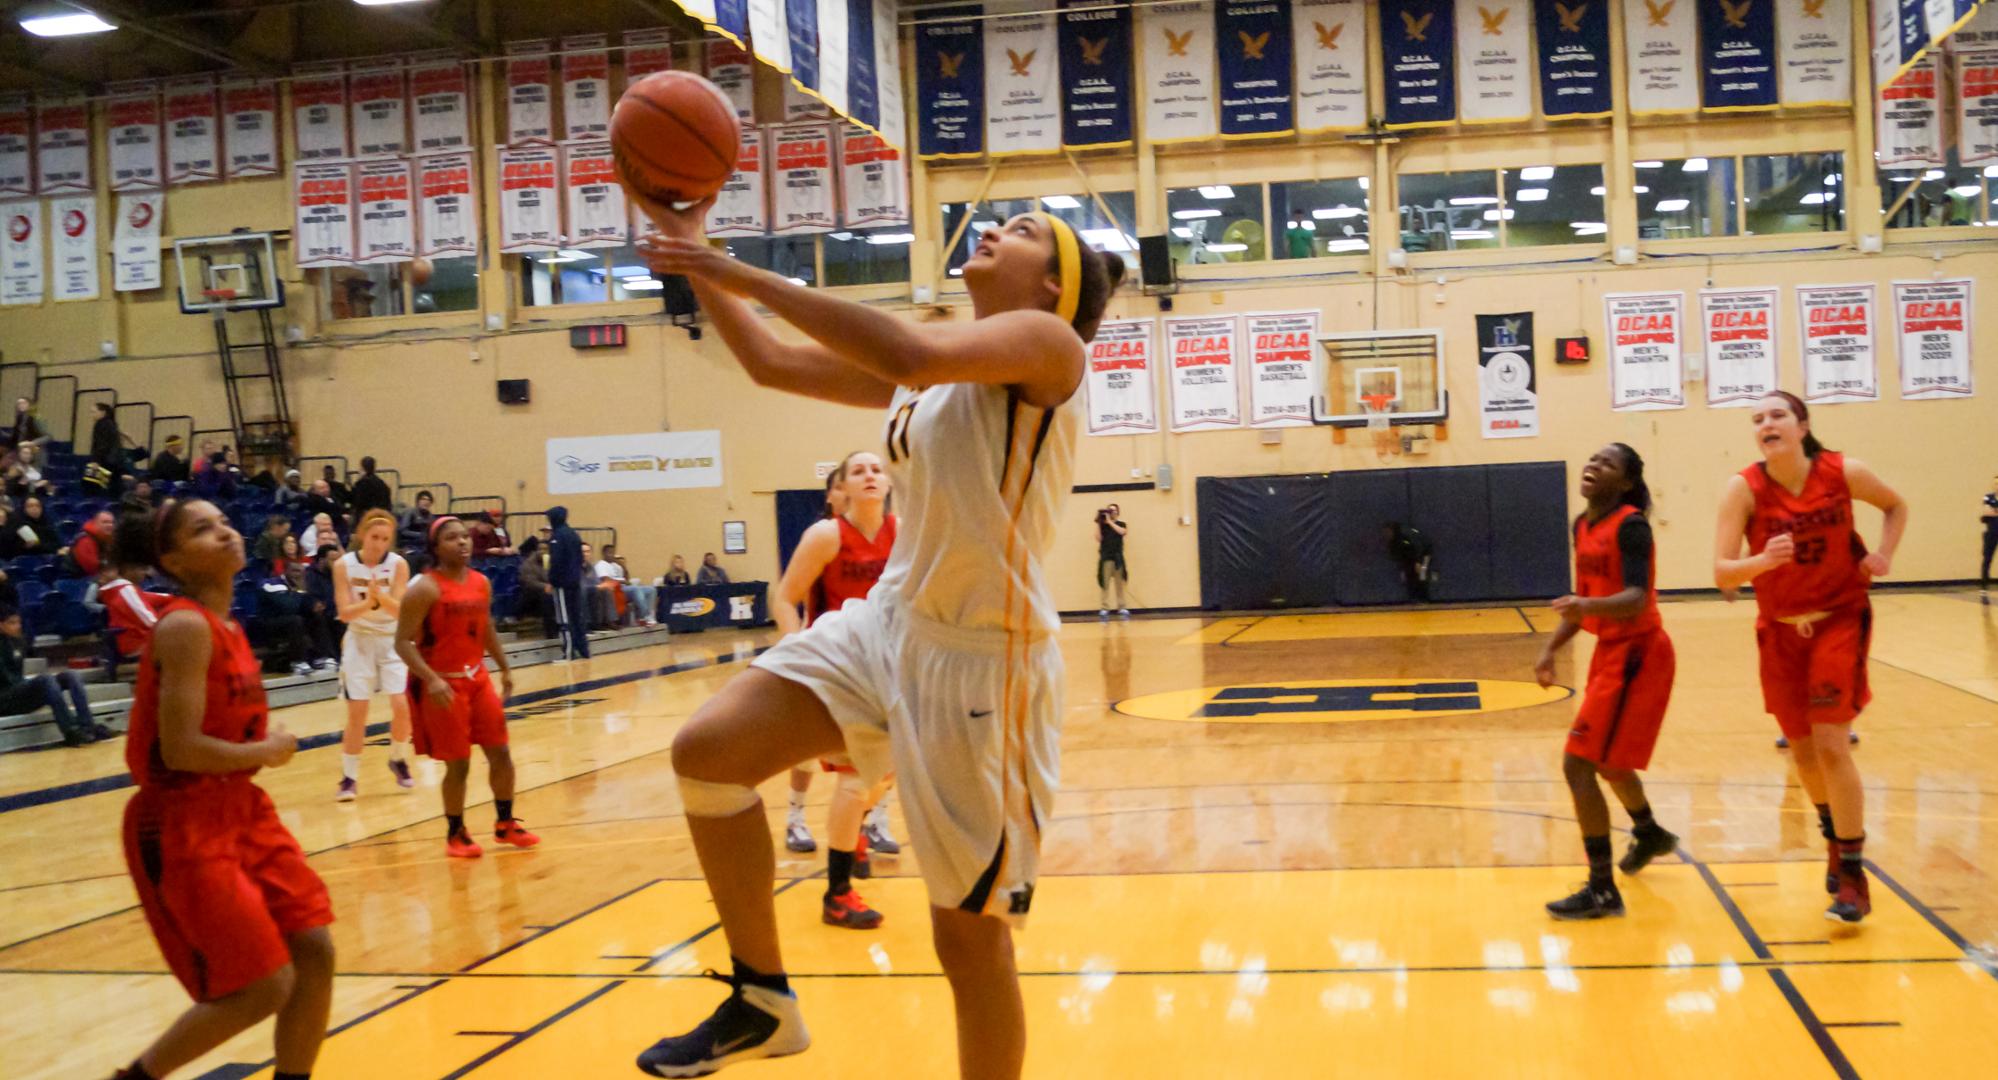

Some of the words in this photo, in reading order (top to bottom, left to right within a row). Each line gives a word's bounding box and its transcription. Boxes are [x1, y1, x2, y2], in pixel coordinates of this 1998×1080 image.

[1905, 301, 1962, 318] OCAA
[1810, 306, 1865, 323] OCAA
[1618, 315, 1673, 331] OCAA
[1711, 311, 1768, 328] OCAA
[1255, 333, 1309, 350] OCAA
[1820, 337, 1857, 346] WOMEN'S
[1922, 334, 1949, 342] MEN'S
[1092, 341, 1145, 358] OCAA
[1176, 336, 1229, 354] OCAA
[1722, 342, 1762, 350] WOMEN'S
[1633, 346, 1660, 354] MEN'S
[1624, 355, 1669, 364] BADMINTON
[1719, 351, 1764, 360] BADMINTON
[1186, 368, 1223, 376] WOMEN'S
[1265, 364, 1303, 372] WOMEN'S
[1181, 376, 1227, 385] VOLLEYBALL
[1260, 373, 1307, 382] BASKETBALL
[1912, 376, 1958, 385] 2014-2015
[1719, 384, 1765, 394] 2014-2015
[1818, 380, 1863, 390] 2014-2015
[1625, 388, 1671, 398] 2014-2015
[1184, 408, 1227, 418] 2014-2015
[1263, 405, 1307, 414] 2014-2015
[1100, 412, 1143, 422] 2014-2015
